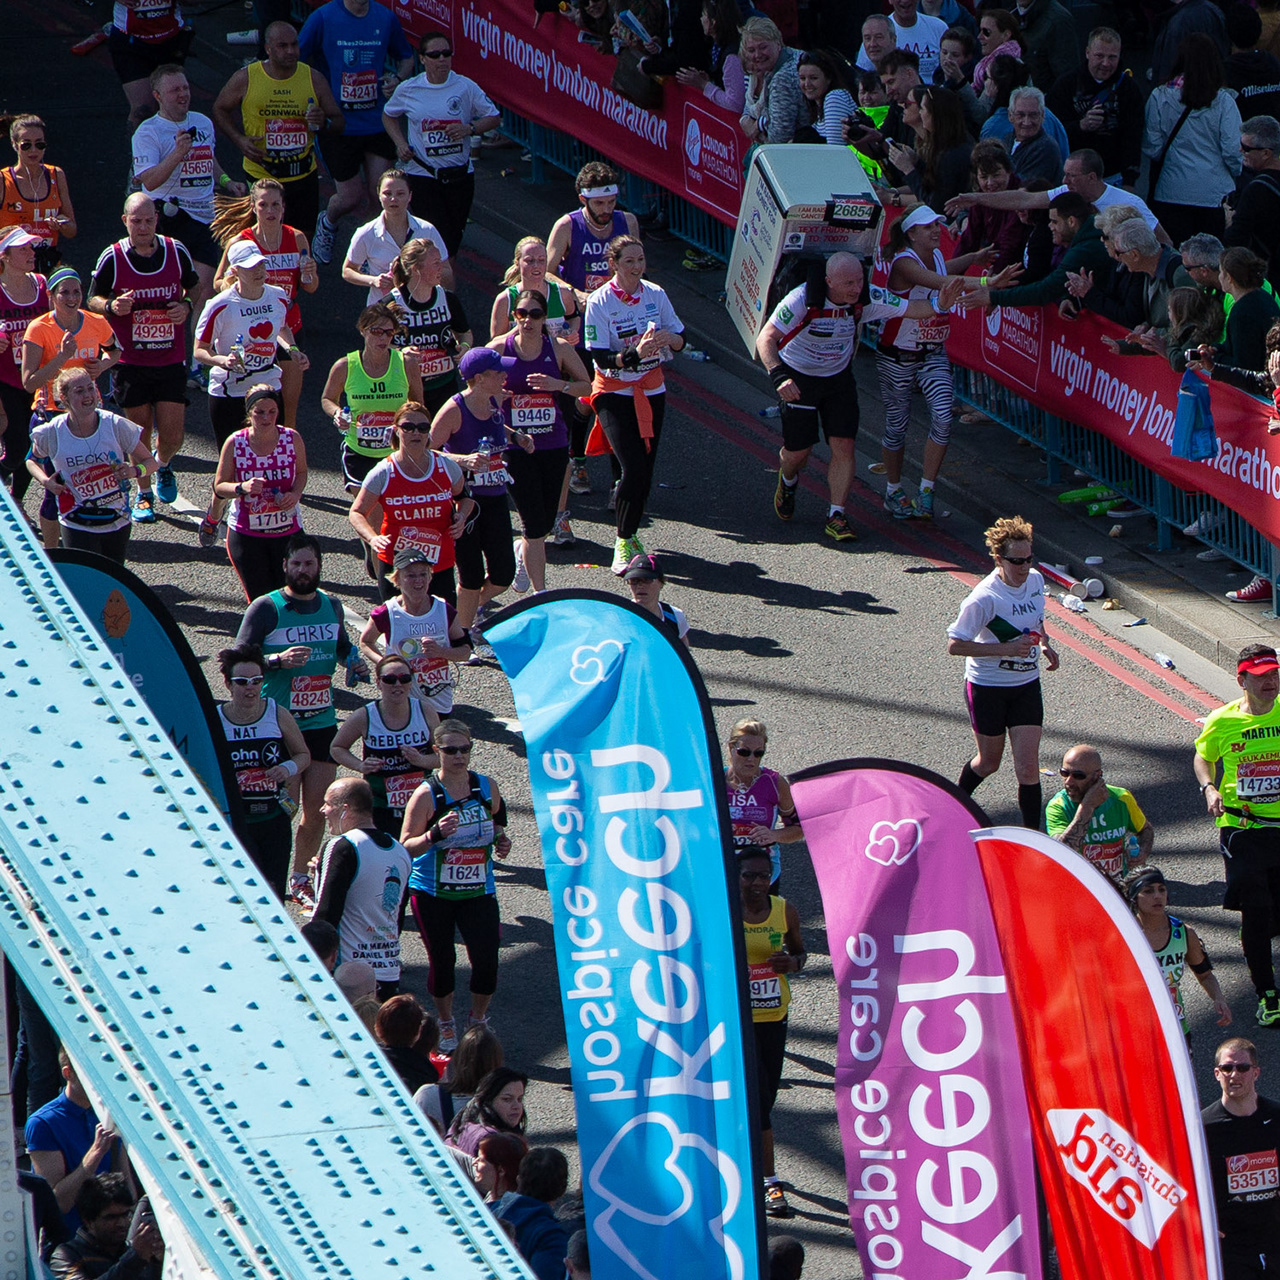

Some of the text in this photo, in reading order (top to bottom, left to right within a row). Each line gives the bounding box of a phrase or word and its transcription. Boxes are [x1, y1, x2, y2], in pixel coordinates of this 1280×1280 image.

[462, 7, 501, 60] virgin
[503, 29, 551, 93] money
[552, 50, 600, 111] london
[341, 83, 377, 99] 54241
[266, 132, 308, 148] 50340
[701, 133, 728, 160] LONDON
[182, 160, 213, 175] 45650
[701, 153, 739, 184] MARATHON
[687, 169, 703, 184] money
[833, 202, 874, 218] 26854
[240, 304, 273, 317] LOUISE
[1002, 306, 1032, 331] LONDON
[133, 324, 174, 339] 49294
[394, 333, 439, 346] St John
[984, 337, 1000, 356] money
[1001, 322, 1039, 358] MARATHON
[370, 381, 386, 393] JO
[1050, 335, 1148, 436] virgin money
[518, 409, 551, 422] 9446
[66, 451, 111, 466] BECKY
[79, 477, 117, 498] 39148
[255, 511, 288, 528] 1718
[394, 506, 442, 520] CLAIRE
[418, 531, 441, 542] money
[1012, 600, 1037, 615] ANN
[286, 624, 335, 644] CHRIS
[410, 623, 437, 635] KIM
[291, 691, 330, 708] 48243
[233, 726, 258, 740] NAT
[370, 731, 428, 747] REBECCA
[447, 863, 481, 880] 1624
[1249, 1154, 1277, 1167] money
[1229, 1170, 1279, 1191] 53513
[1246, 1190, 1277, 1203] #boost
